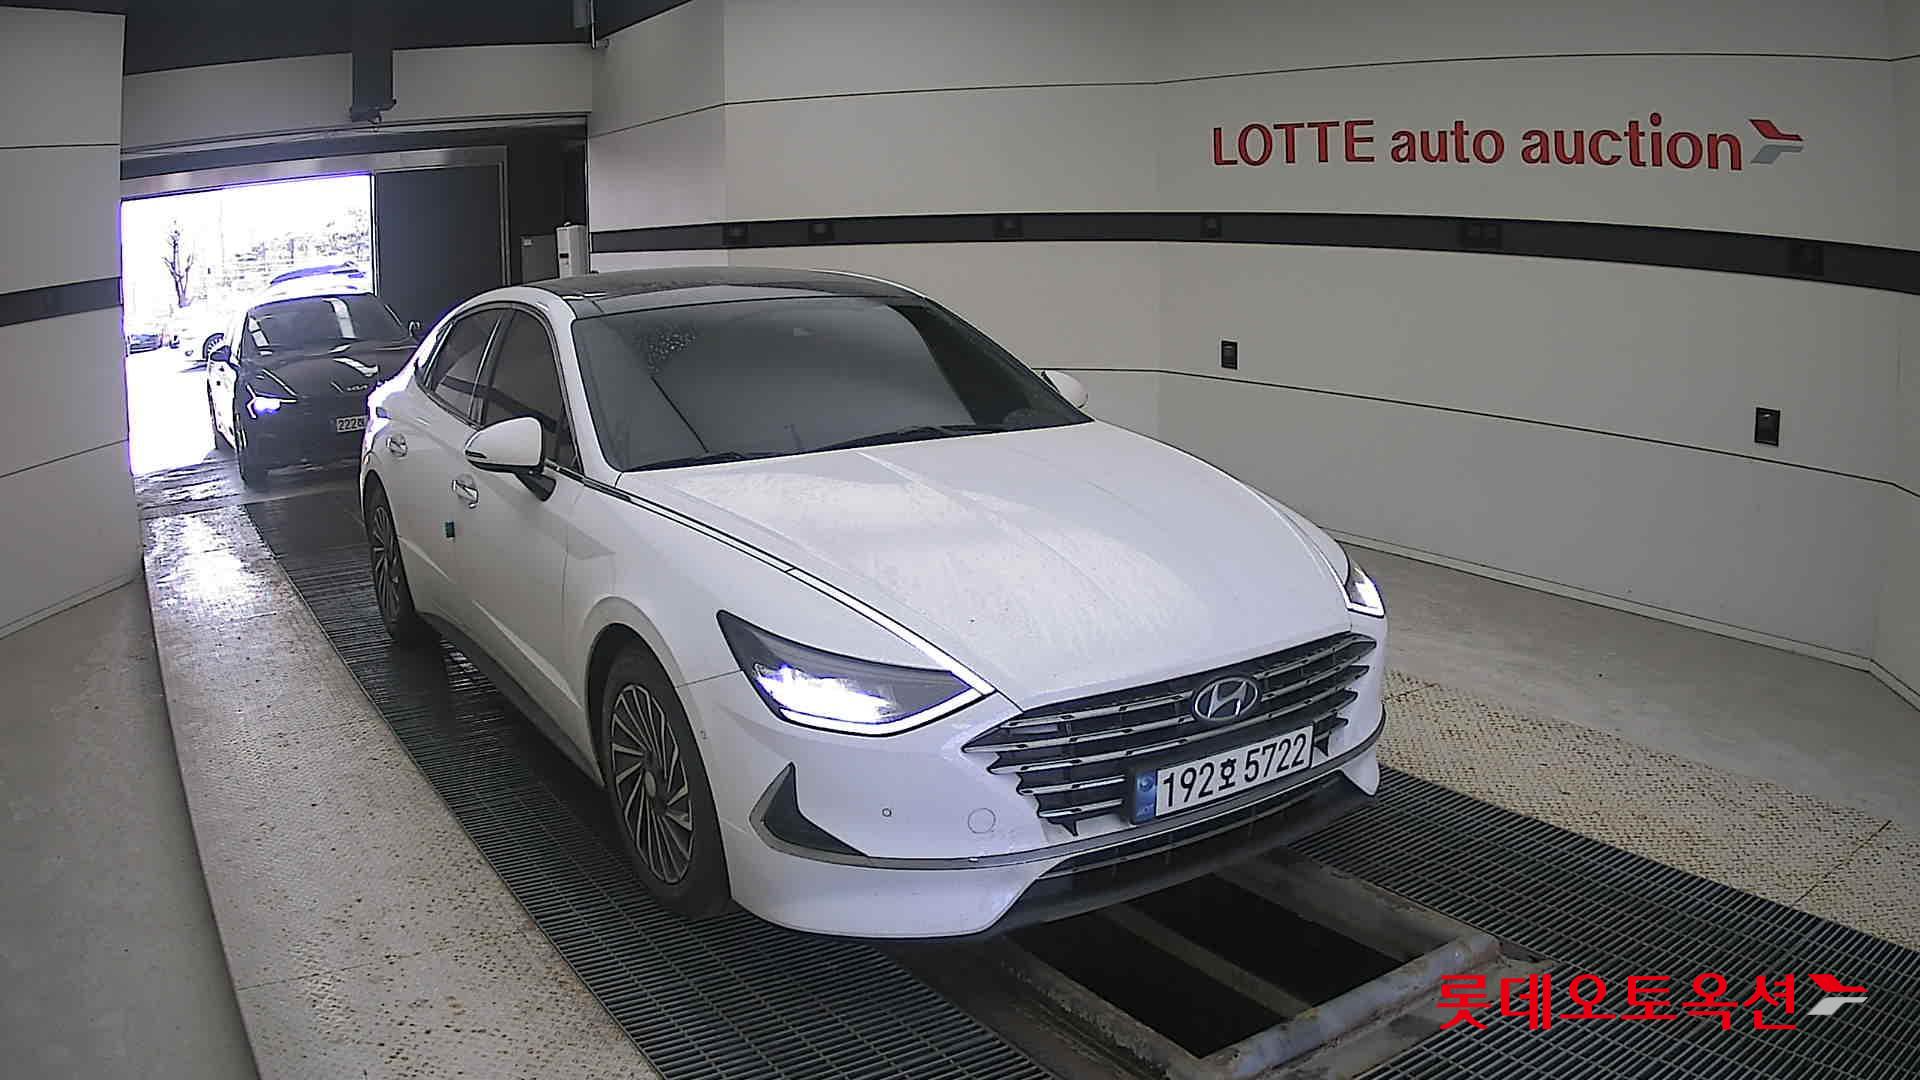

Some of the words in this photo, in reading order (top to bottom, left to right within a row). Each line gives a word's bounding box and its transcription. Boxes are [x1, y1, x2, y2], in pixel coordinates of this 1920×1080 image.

[1213, 119, 1375, 166] LOTTE
[1391, 120, 1505, 164] auto
[1521, 112, 1743, 171] auction
[1163, 758, 1237, 807] 192호
[1244, 733, 1307, 783] 5722
